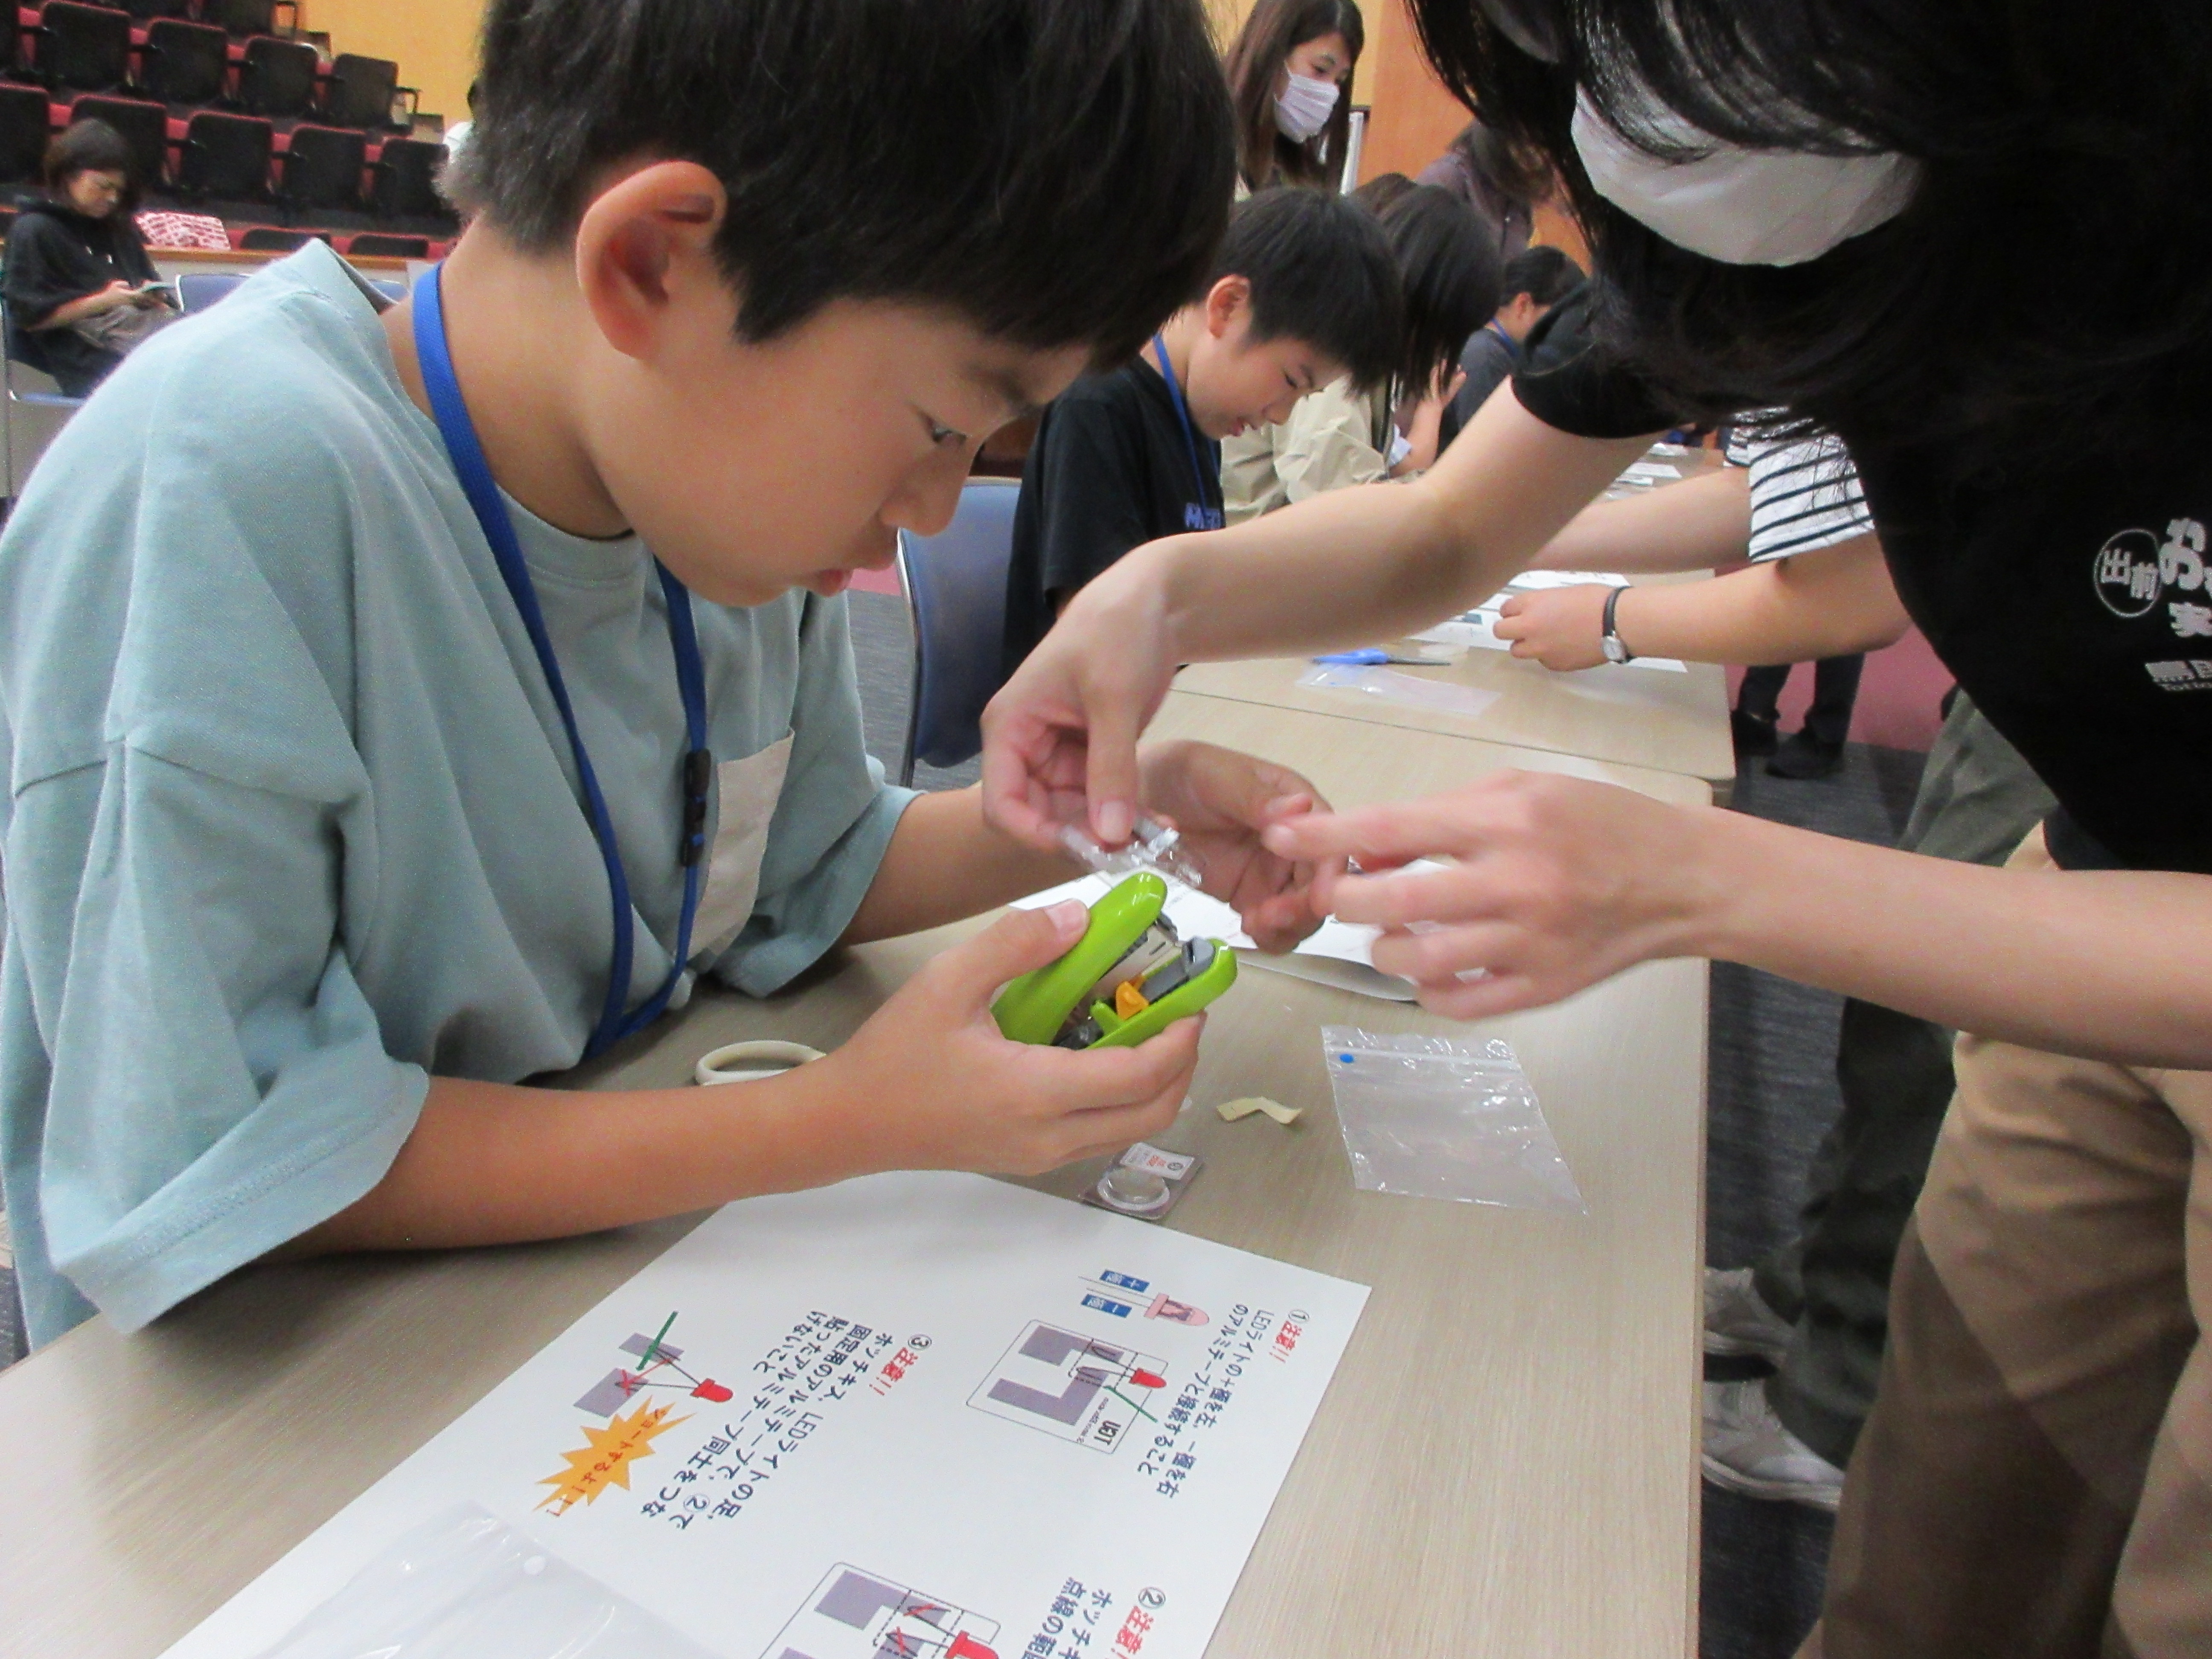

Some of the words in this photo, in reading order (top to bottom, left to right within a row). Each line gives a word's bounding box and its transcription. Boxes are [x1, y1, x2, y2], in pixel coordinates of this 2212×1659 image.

[2159, 517, 2212, 593] お
[641, 1316, 849, 1518] 貼ったアルミテープ同士をつな
